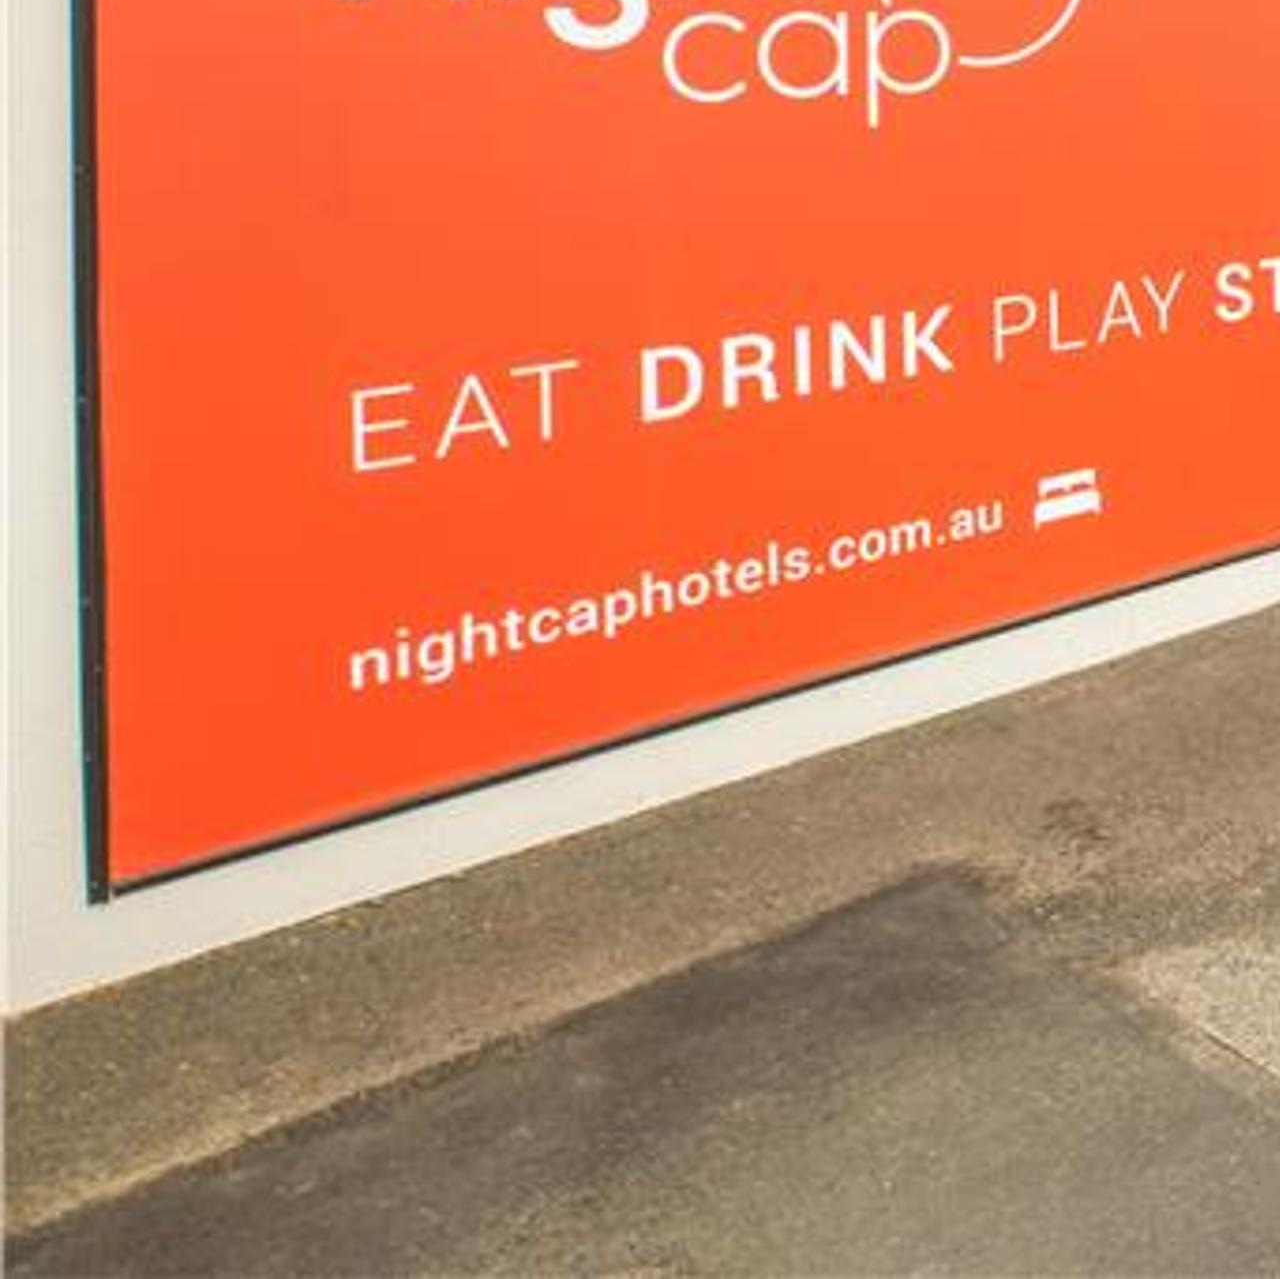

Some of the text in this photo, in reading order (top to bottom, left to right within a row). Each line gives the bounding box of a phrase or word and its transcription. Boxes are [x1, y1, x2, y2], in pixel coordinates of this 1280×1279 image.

[661, 9, 953, 129] cap
[351, 358, 579, 472] EAT
[640, 304, 954, 424] DRINK
[992, 271, 1184, 362] PLAY
[349, 498, 1003, 690] nightcaphotels.com.au
